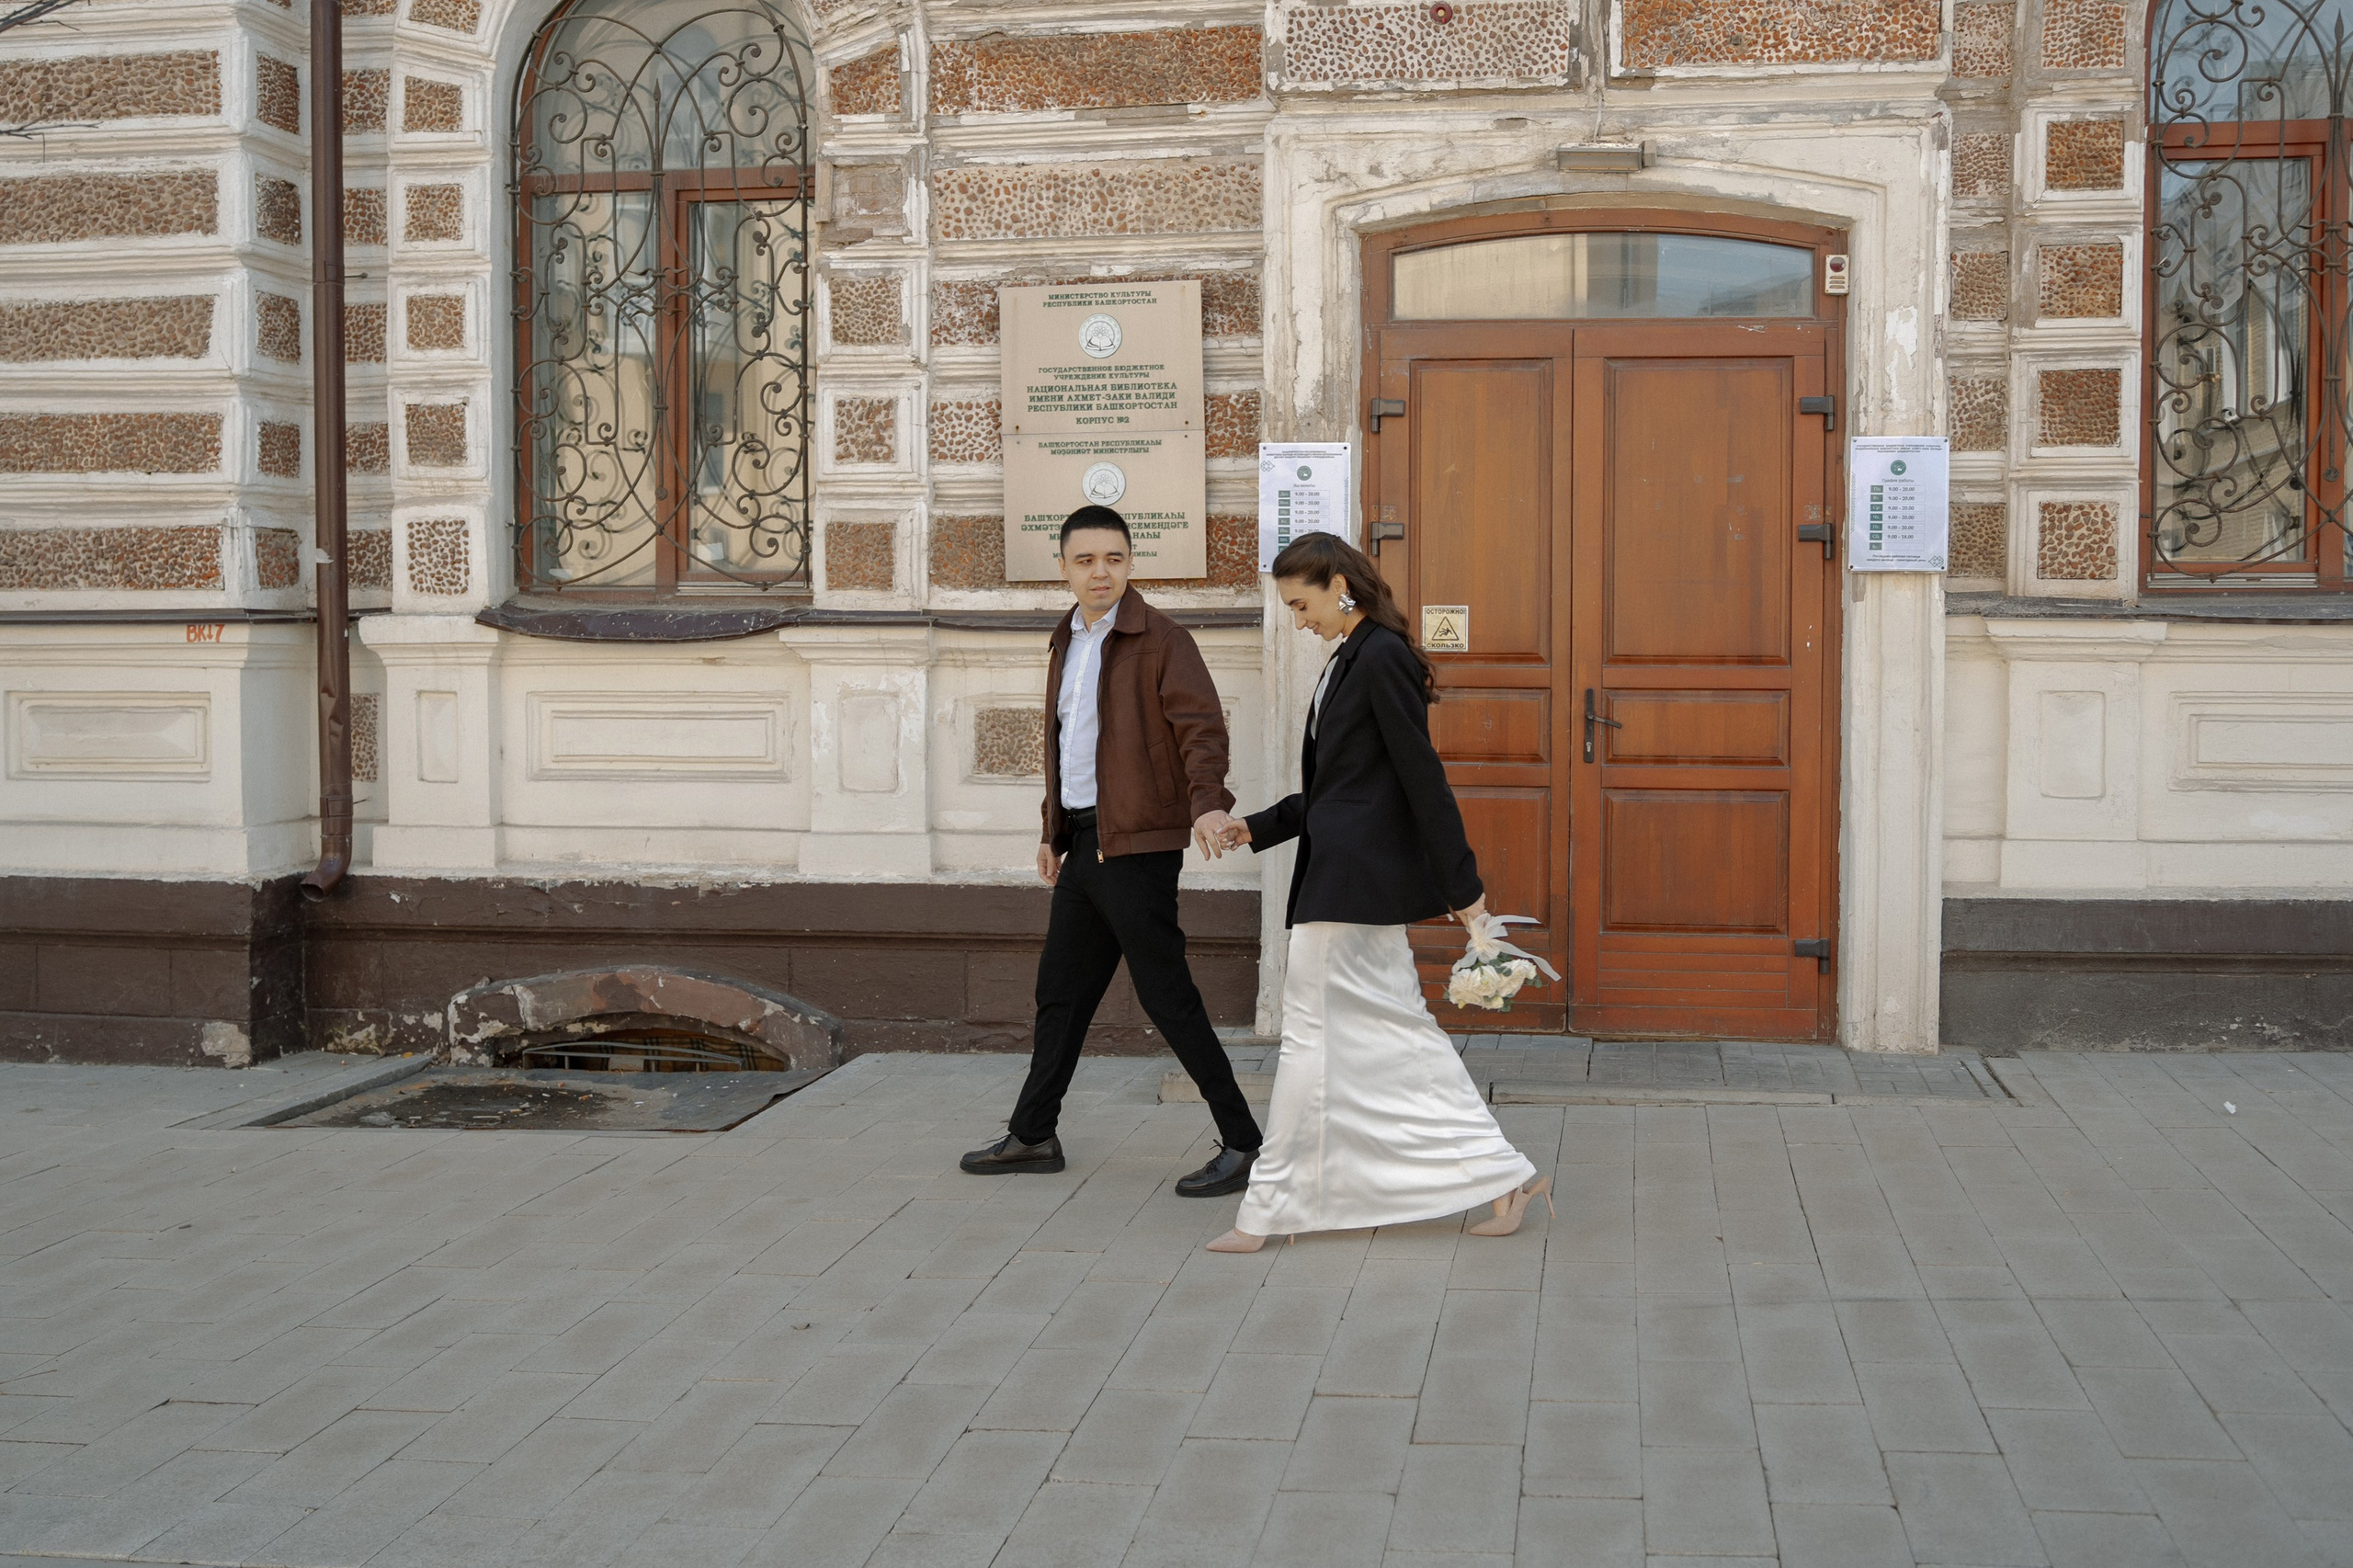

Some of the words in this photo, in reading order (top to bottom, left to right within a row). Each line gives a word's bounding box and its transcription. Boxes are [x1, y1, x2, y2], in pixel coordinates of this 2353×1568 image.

[1049, 291, 1108, 301] МИНИСТЕРСТВО
[1110, 290, 1152, 299] КУЛЬТУРЫ
[1042, 300, 1093, 308] РЕСПУБЛИКИ
[1095, 298, 1157, 306] БАШКОРТОСТАН
[1039, 365, 1113, 374] ГОСУДАРСТВЕННОЕ
[1027, 384, 1108, 394] НАЦИОНАЛЬНАЯ
[1110, 382, 1177, 391] БИБЛИОТЕКА
[1067, 393, 1131, 402] АХМЕТ-ЗАКИ
[1135, 392, 1176, 401] ВАЛИДИ
[1028, 403, 1093, 413] РЕСПУБЛИКИ
[1096, 402, 1177, 411] БАШКОРТОСТАН
[1075, 416, 1114, 425] КОРПУС
